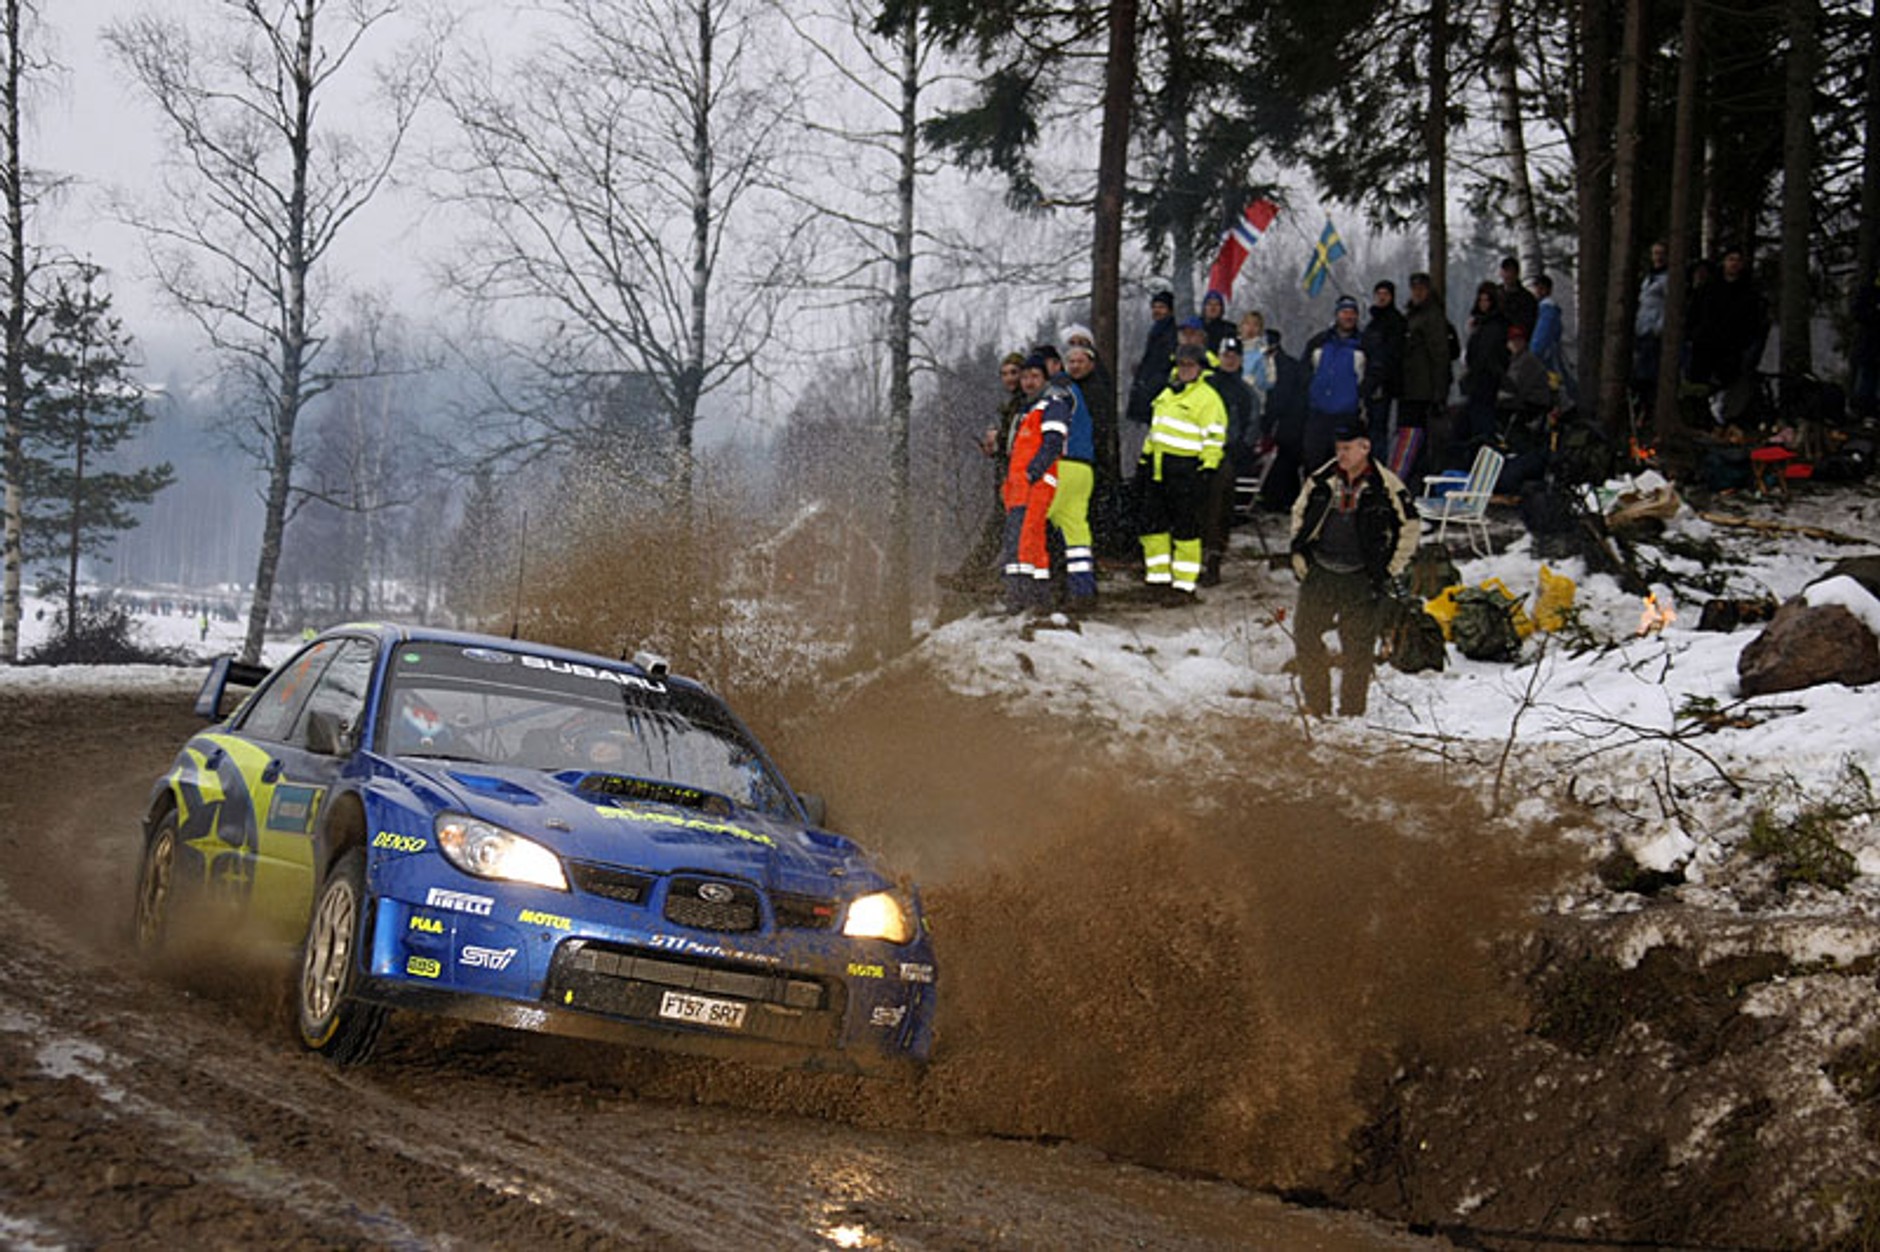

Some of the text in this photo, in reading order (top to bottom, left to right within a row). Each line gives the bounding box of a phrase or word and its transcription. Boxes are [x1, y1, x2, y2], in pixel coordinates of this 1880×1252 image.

[521, 655, 667, 694] SUBARU
[372, 831, 427, 852] DENSO
[426, 887, 495, 915] PIRELLI
[409, 916, 444, 934] PIAA
[518, 909, 573, 931] MOTUL
[664, 996, 743, 1023] FT57 SRT
